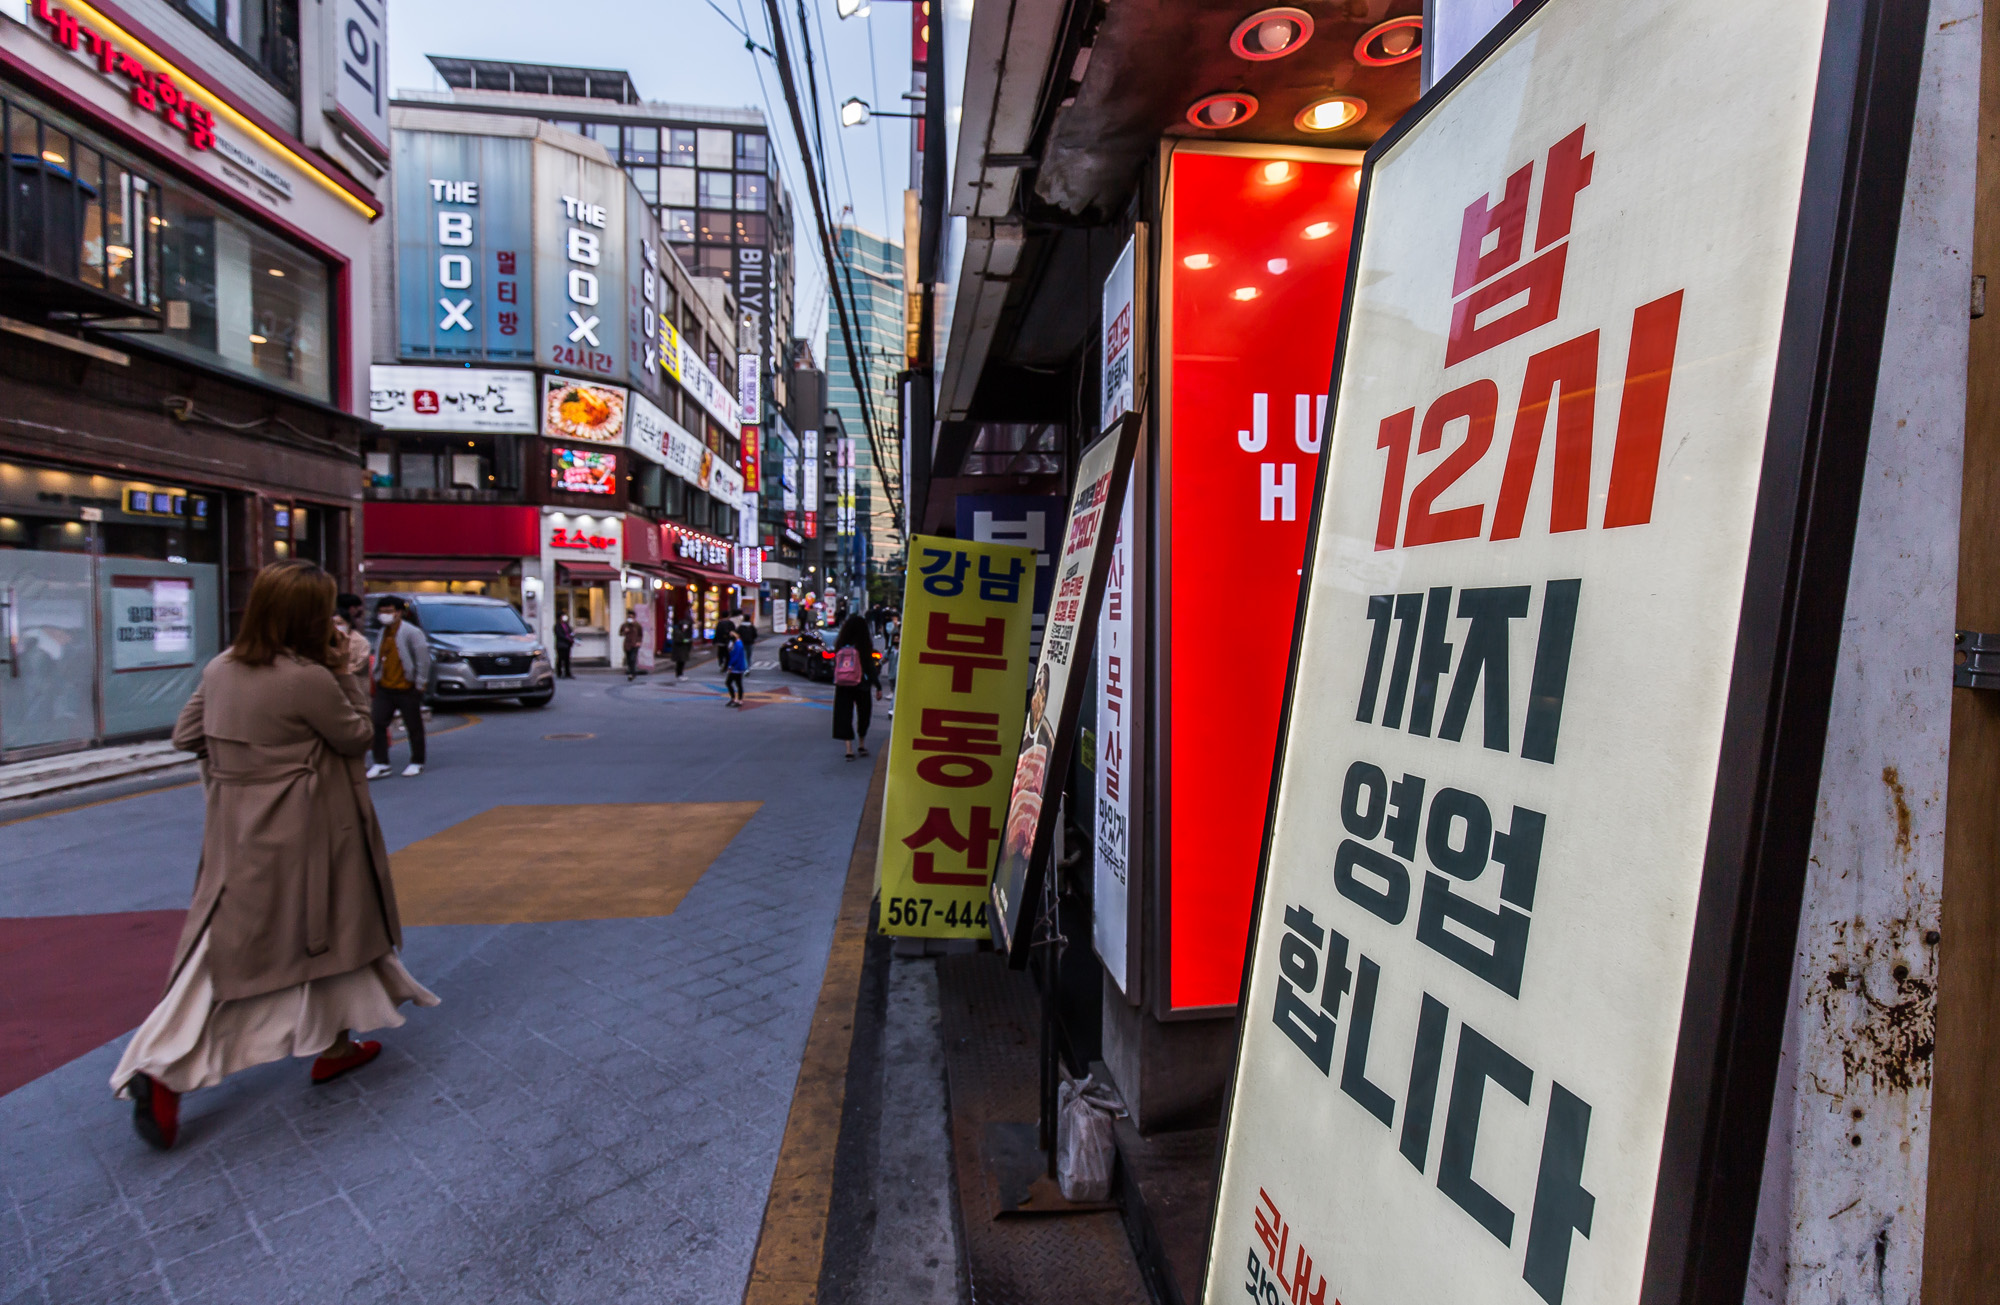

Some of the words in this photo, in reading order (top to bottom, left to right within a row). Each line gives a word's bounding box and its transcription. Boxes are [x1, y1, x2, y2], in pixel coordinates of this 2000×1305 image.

[344, 0, 380, 117] 의
[429, 179, 478, 204] THE
[562, 195, 607, 229] THE
[1445, 123, 1594, 368] 밤
[438, 211, 473, 331] BOX
[497, 251, 518, 336] 멀티방
[568, 227, 600, 347] BOX
[643, 268, 656, 375] BOX
[553, 345, 613, 373] 24시간
[1375, 289, 1684, 551] 12시
[920, 548, 1026, 603] 강남
[1067, 508, 1101, 556] 맛있다!
[1104, 656, 1123, 803] 목살
[1357, 579, 1582, 763] 까지
[902, 612, 1007, 886] 부동산
[1099, 798, 1126, 857] 맛있게
[1335, 761, 1546, 999] 영업
[888, 897, 988, 928] 567-444
[1274, 904, 1595, 1303] 합니다
